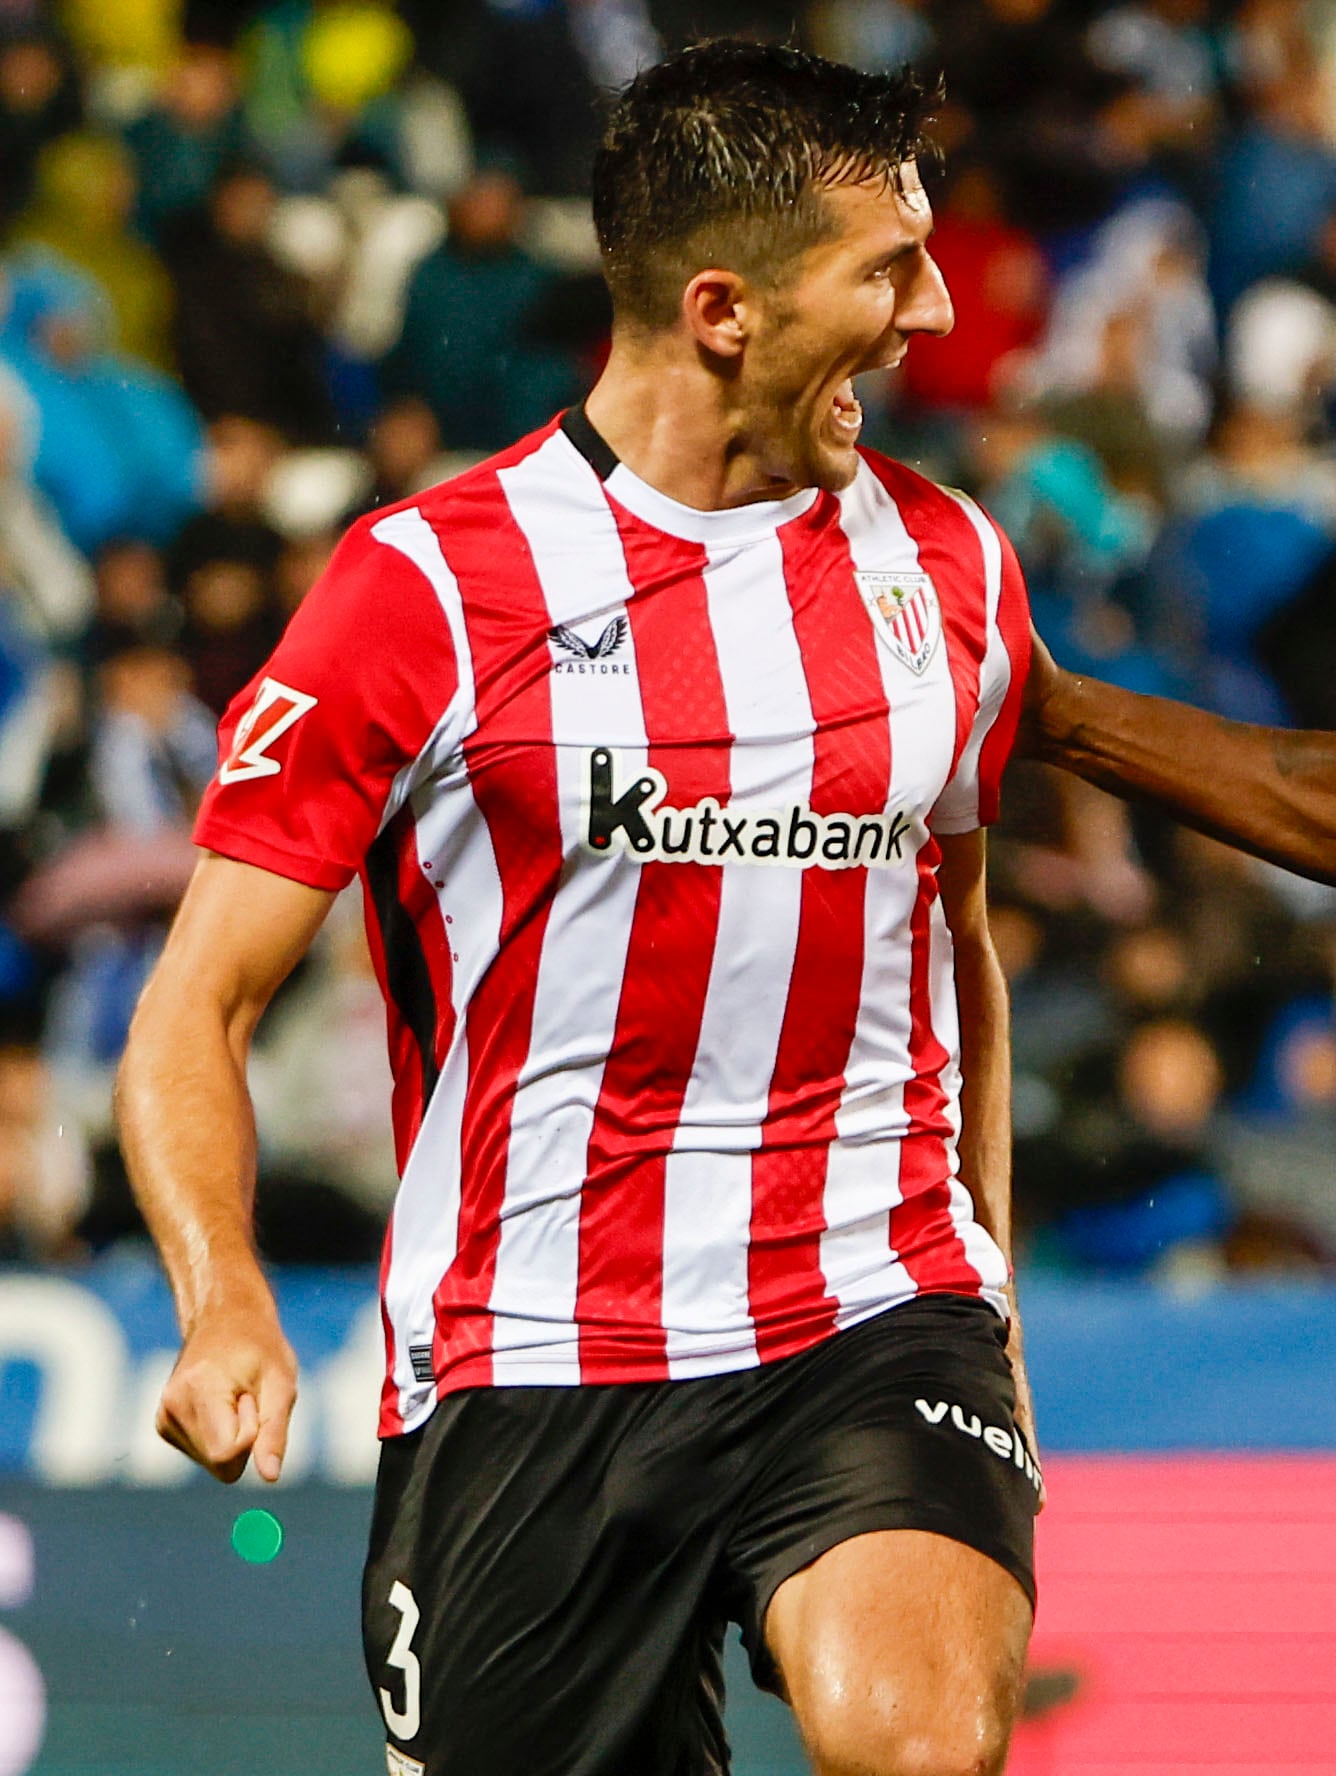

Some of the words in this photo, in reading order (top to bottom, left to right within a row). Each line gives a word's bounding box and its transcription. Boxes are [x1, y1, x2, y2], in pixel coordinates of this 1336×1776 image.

[554, 663, 630, 674] CASTORE
[588, 746, 911, 861] Kutxabank
[379, 1579, 421, 1741] 3
